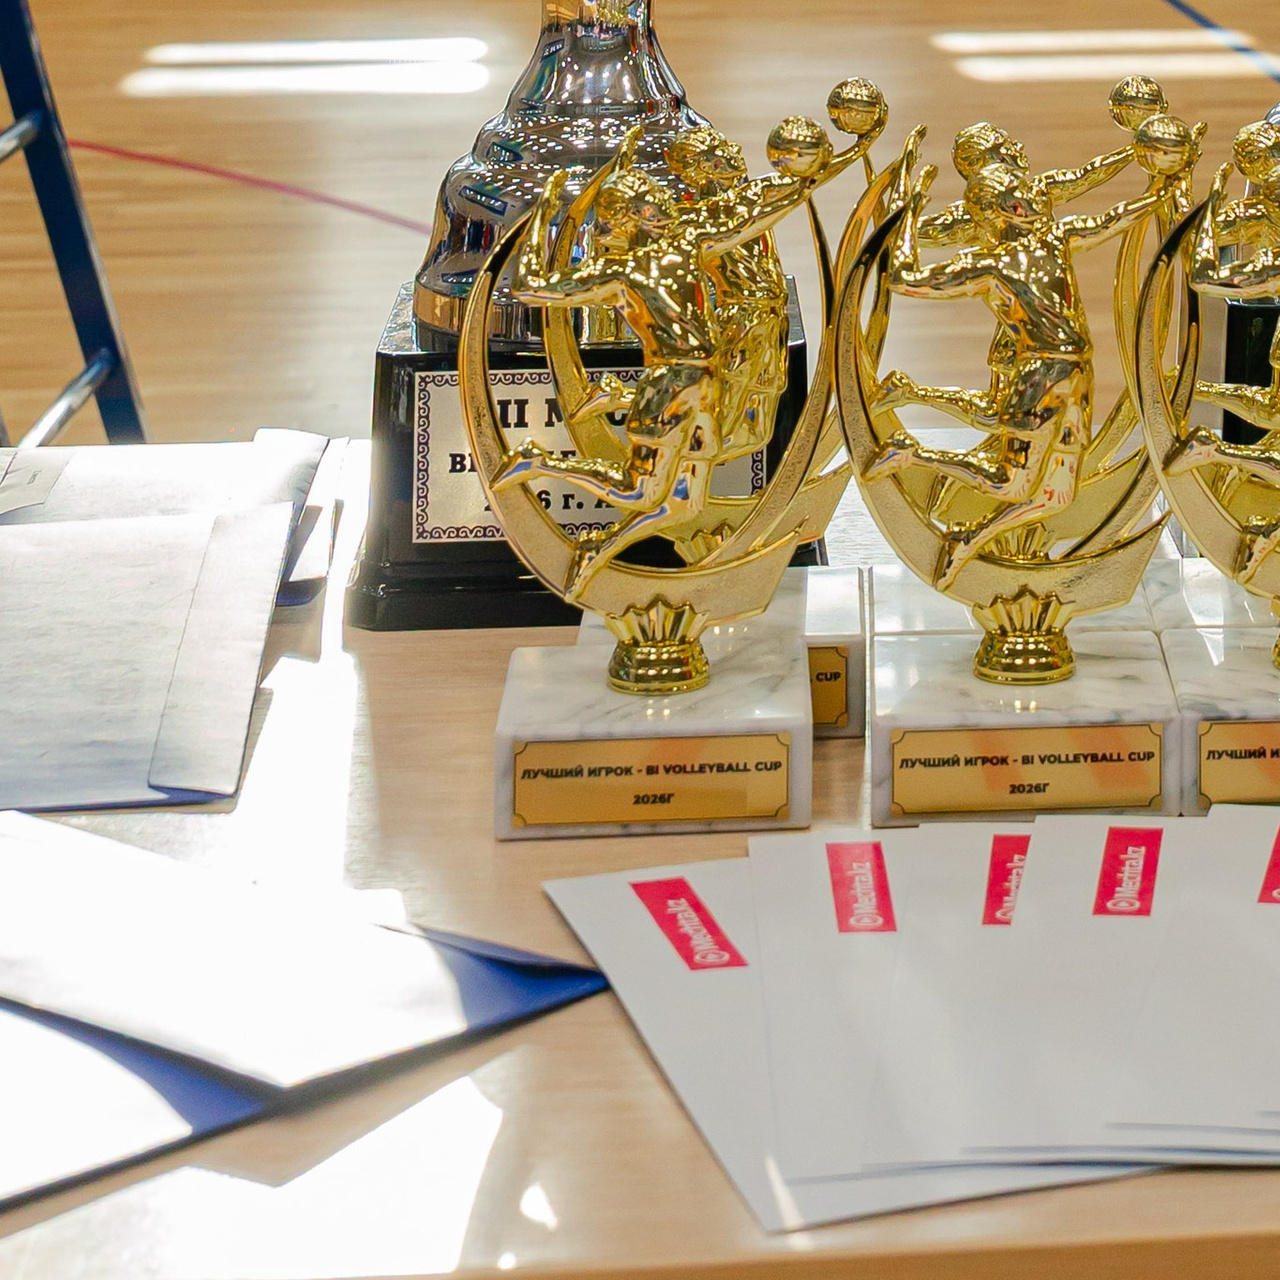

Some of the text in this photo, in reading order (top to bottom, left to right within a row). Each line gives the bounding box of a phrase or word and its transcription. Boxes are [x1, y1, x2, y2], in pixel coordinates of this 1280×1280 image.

[815, 671, 841, 683] CUP
[899, 754, 961, 769] ЛУЧШИЙ
[964, 755, 1010, 766] ИГРОК
[1021, 754, 1034, 765] BI
[1038, 751, 1125, 764] VOLLEYBALL
[1128, 751, 1155, 762] CUP
[1206, 746, 1267, 760] ЛУЧШИЙ
[521, 764, 584, 780] ЛУЧШИЙ
[588, 766, 633, 778] ИГРОК
[646, 765, 659, 776] BI
[663, 762, 751, 775] VOLLEYBALL
[755, 761, 782, 772] CUP
